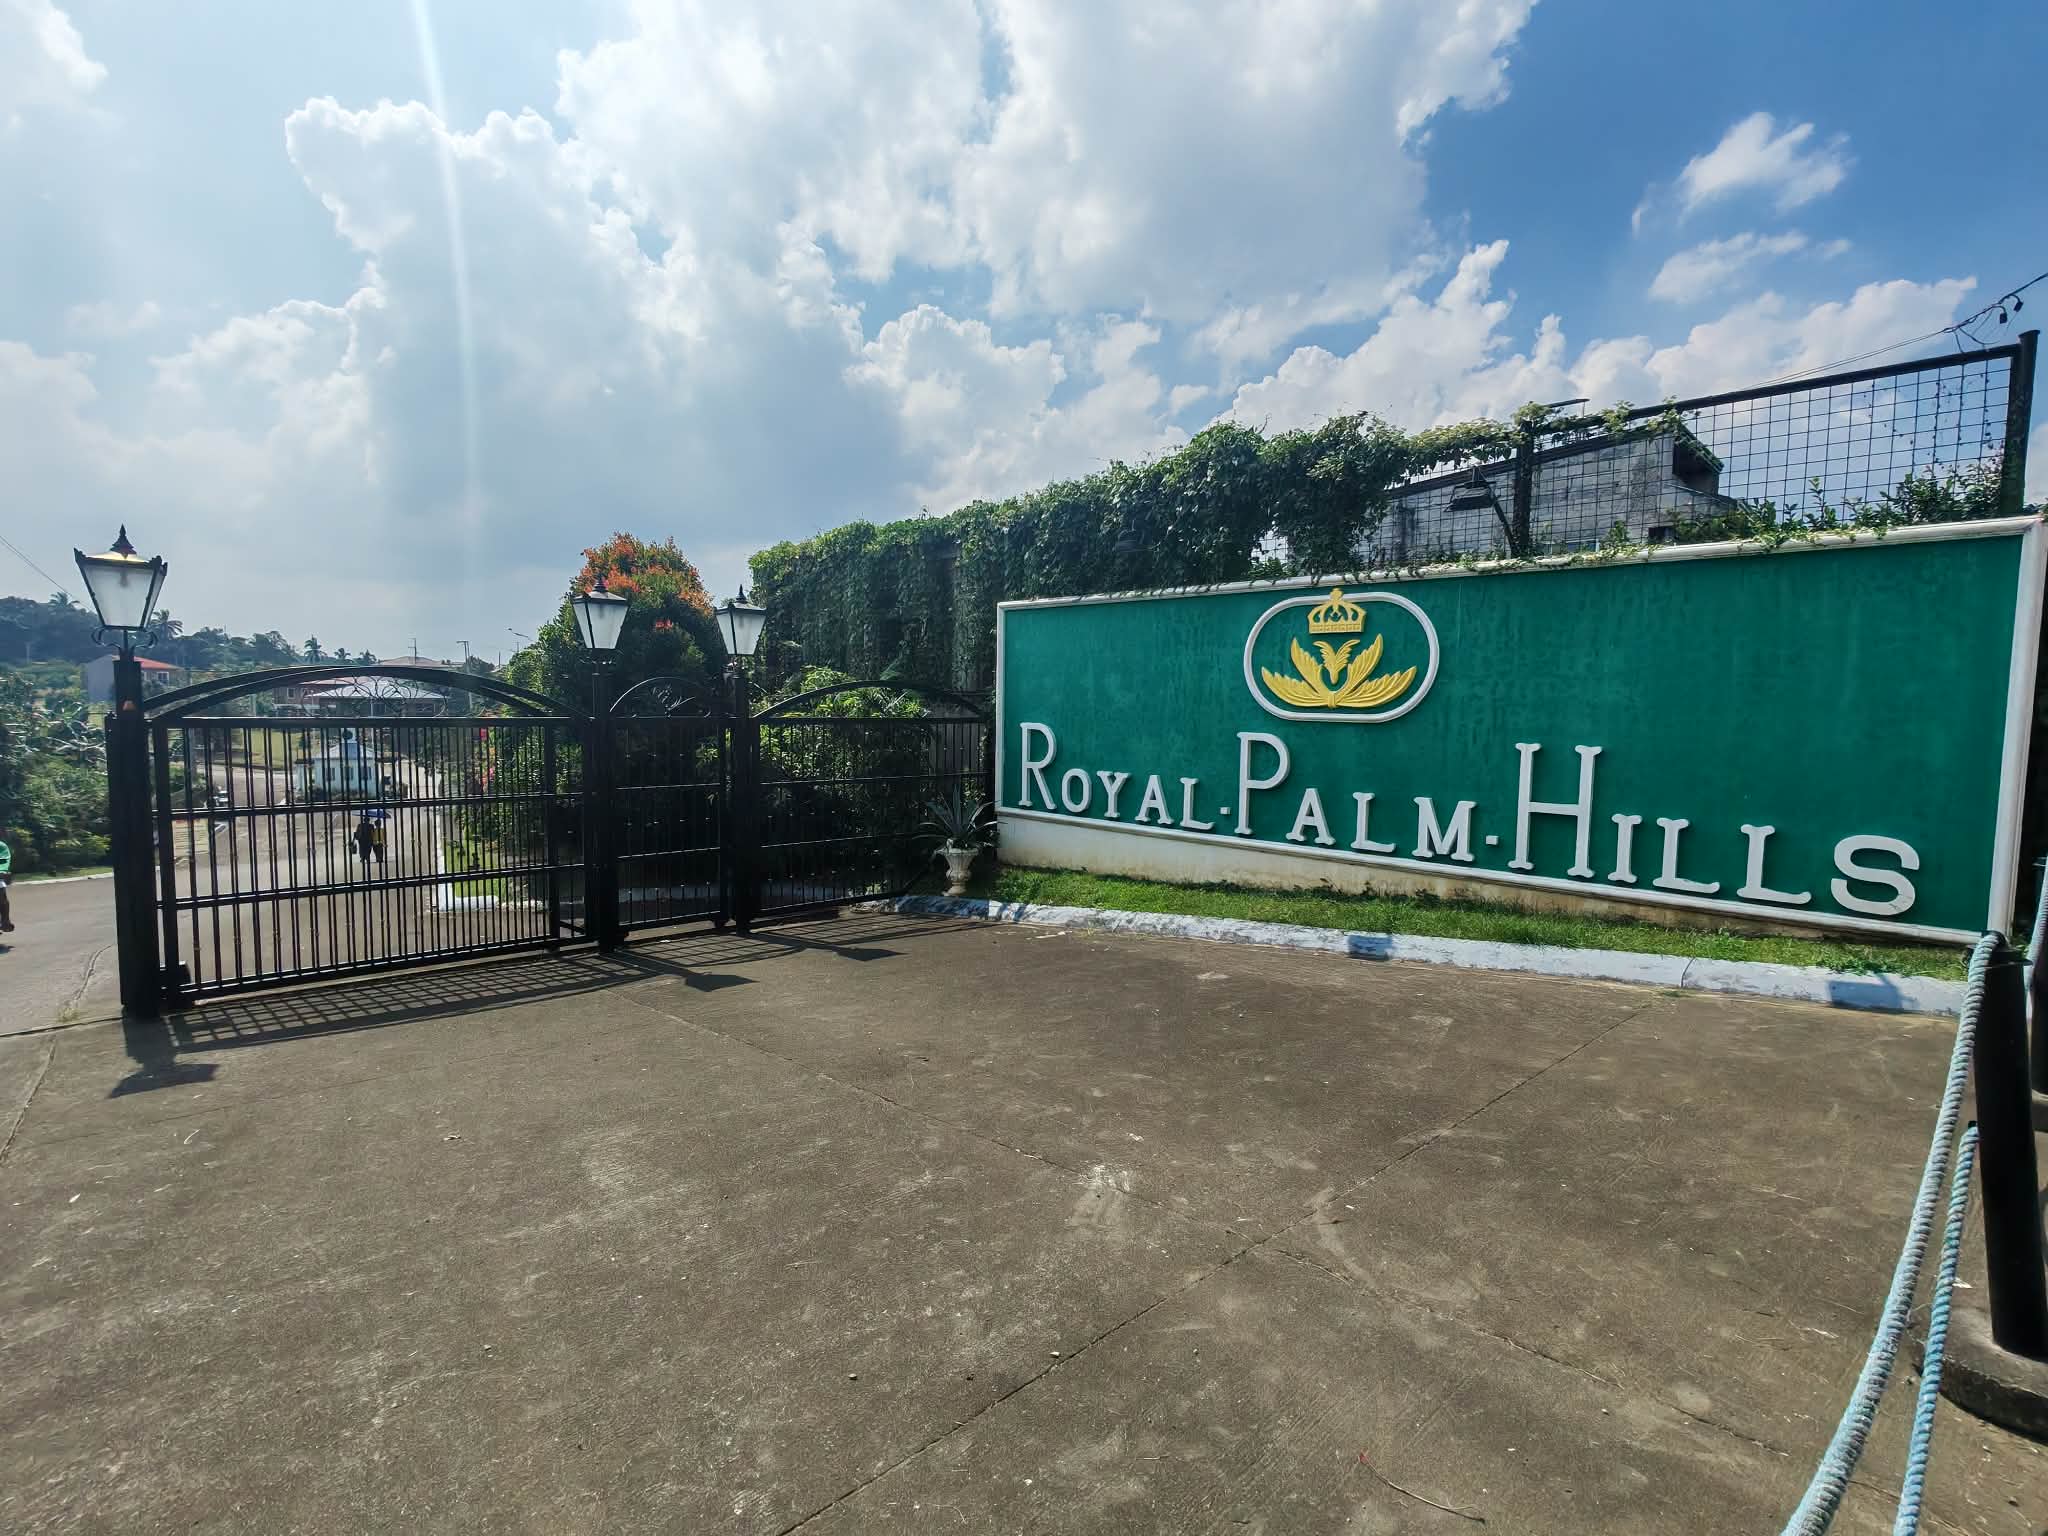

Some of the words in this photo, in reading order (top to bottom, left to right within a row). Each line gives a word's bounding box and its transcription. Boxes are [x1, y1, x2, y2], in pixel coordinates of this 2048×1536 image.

[1018, 721, 1215, 831] ROYAL
[1234, 731, 1476, 862] PALM
[1508, 742, 1920, 916] HILLS
